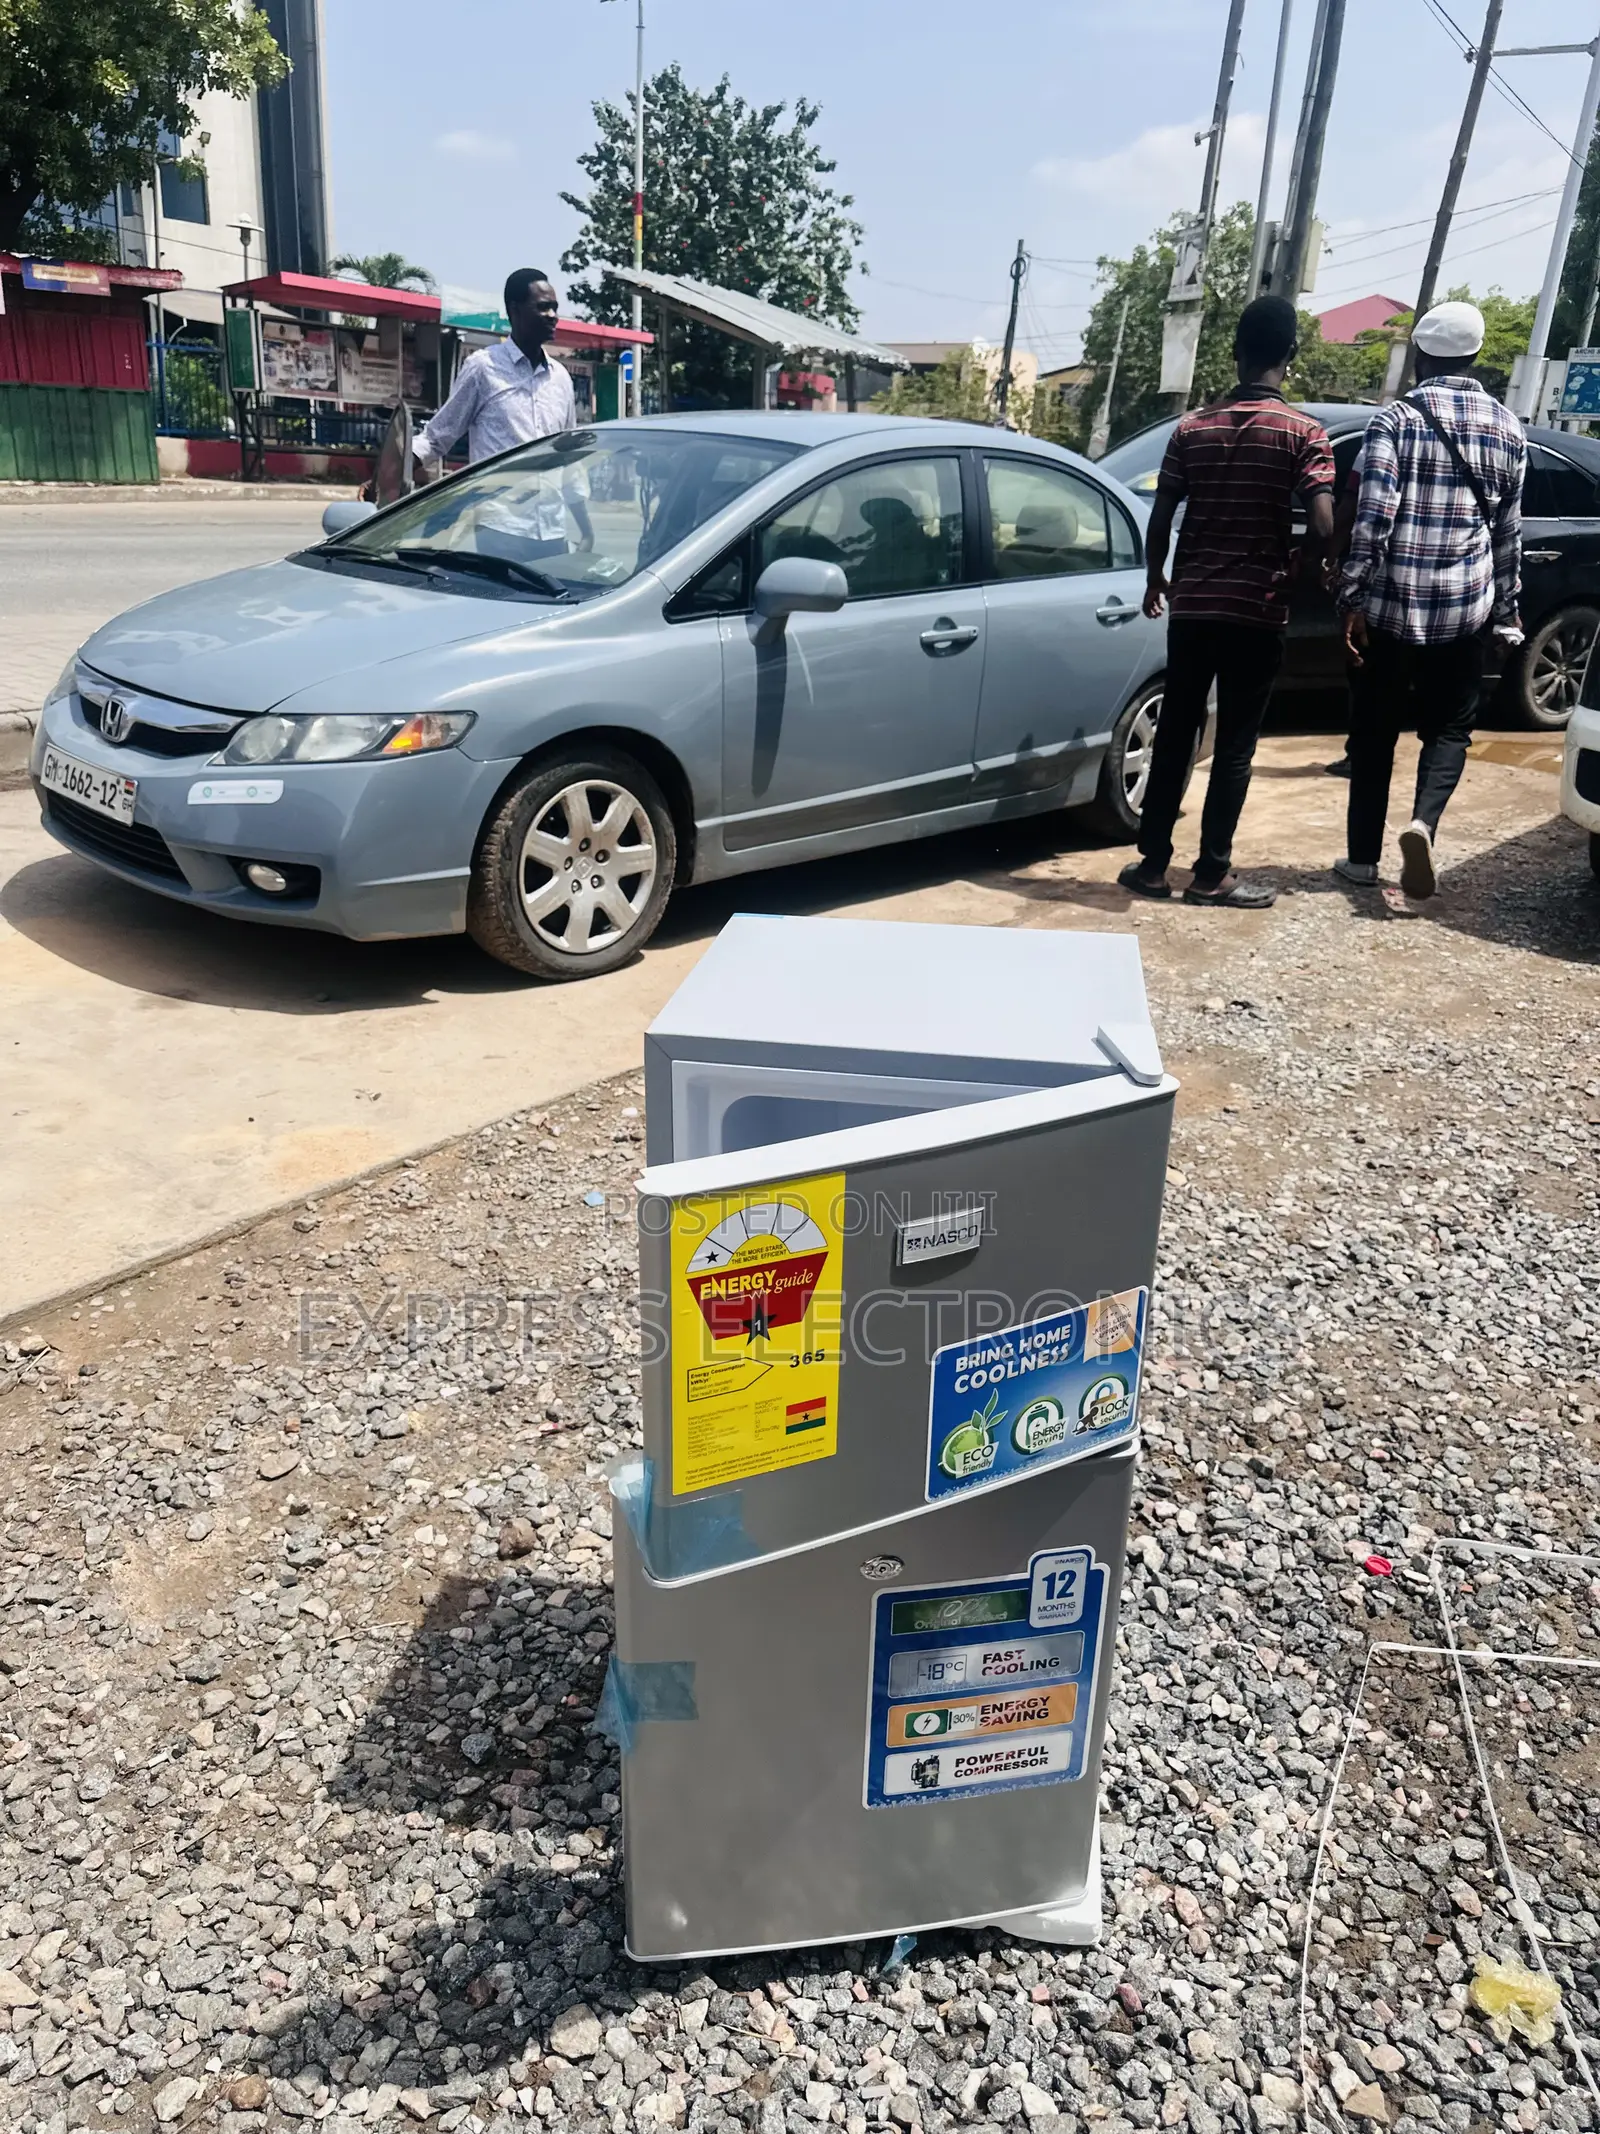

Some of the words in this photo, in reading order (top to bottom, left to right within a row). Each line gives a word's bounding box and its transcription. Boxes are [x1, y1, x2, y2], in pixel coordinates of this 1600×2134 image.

[45, 754, 58, 782] GM
[63, 764, 117, 810] 1662-12
[923, 1225, 978, 1249] NASCO
[700, 1269, 777, 1302] ENERGY
[773, 1268, 813, 1294] guide
[789, 1348, 825, 1368] 365
[955, 1342, 1014, 1373] BRING
[1019, 1324, 1071, 1354] HOME
[954, 1342, 1069, 1394] COOLNESS
[1100, 1396, 1130, 1416] LOCK
[1100, 1409, 1128, 1425] security
[1032, 1420, 1066, 1441] ENERGY
[1032, 1431, 1065, 1448] saving
[962, 1445, 994, 1465] ECO
[962, 1459, 993, 1475] friendly
[1041, 1569, 1077, 1601] 12
[1037, 1601, 1076, 1613] MONTHS
[982, 1649, 1026, 1664] FAST
[981, 1657, 1060, 1677] COOLING
[980, 1696, 1051, 1715] ENERGY
[952, 1712, 976, 1725] 30%
[979, 1708, 1049, 1727] SAVING
[955, 1746, 1049, 1767] POWERFUL
[953, 1757, 1049, 1778] COMPRESSOR
